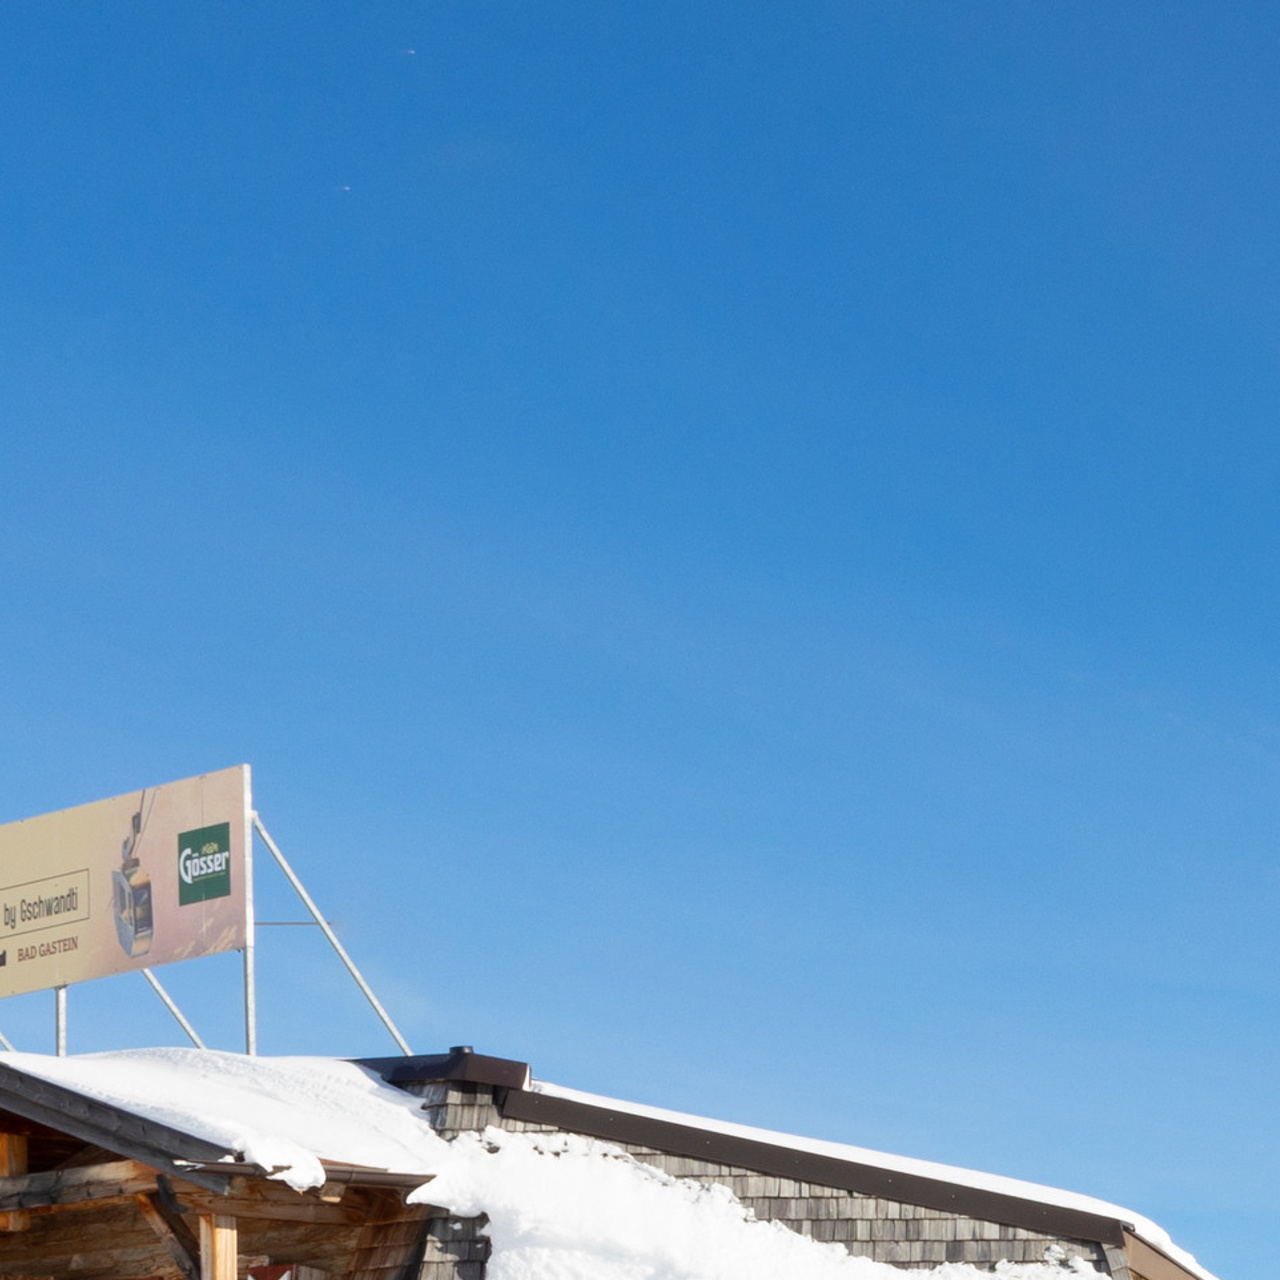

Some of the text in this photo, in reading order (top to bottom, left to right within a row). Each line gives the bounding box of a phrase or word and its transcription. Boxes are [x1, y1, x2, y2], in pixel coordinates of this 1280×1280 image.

[179, 848, 229, 884] Gösser
[4, 903, 16, 929] by
[17, 936, 78, 962] BAD GASTEIN
